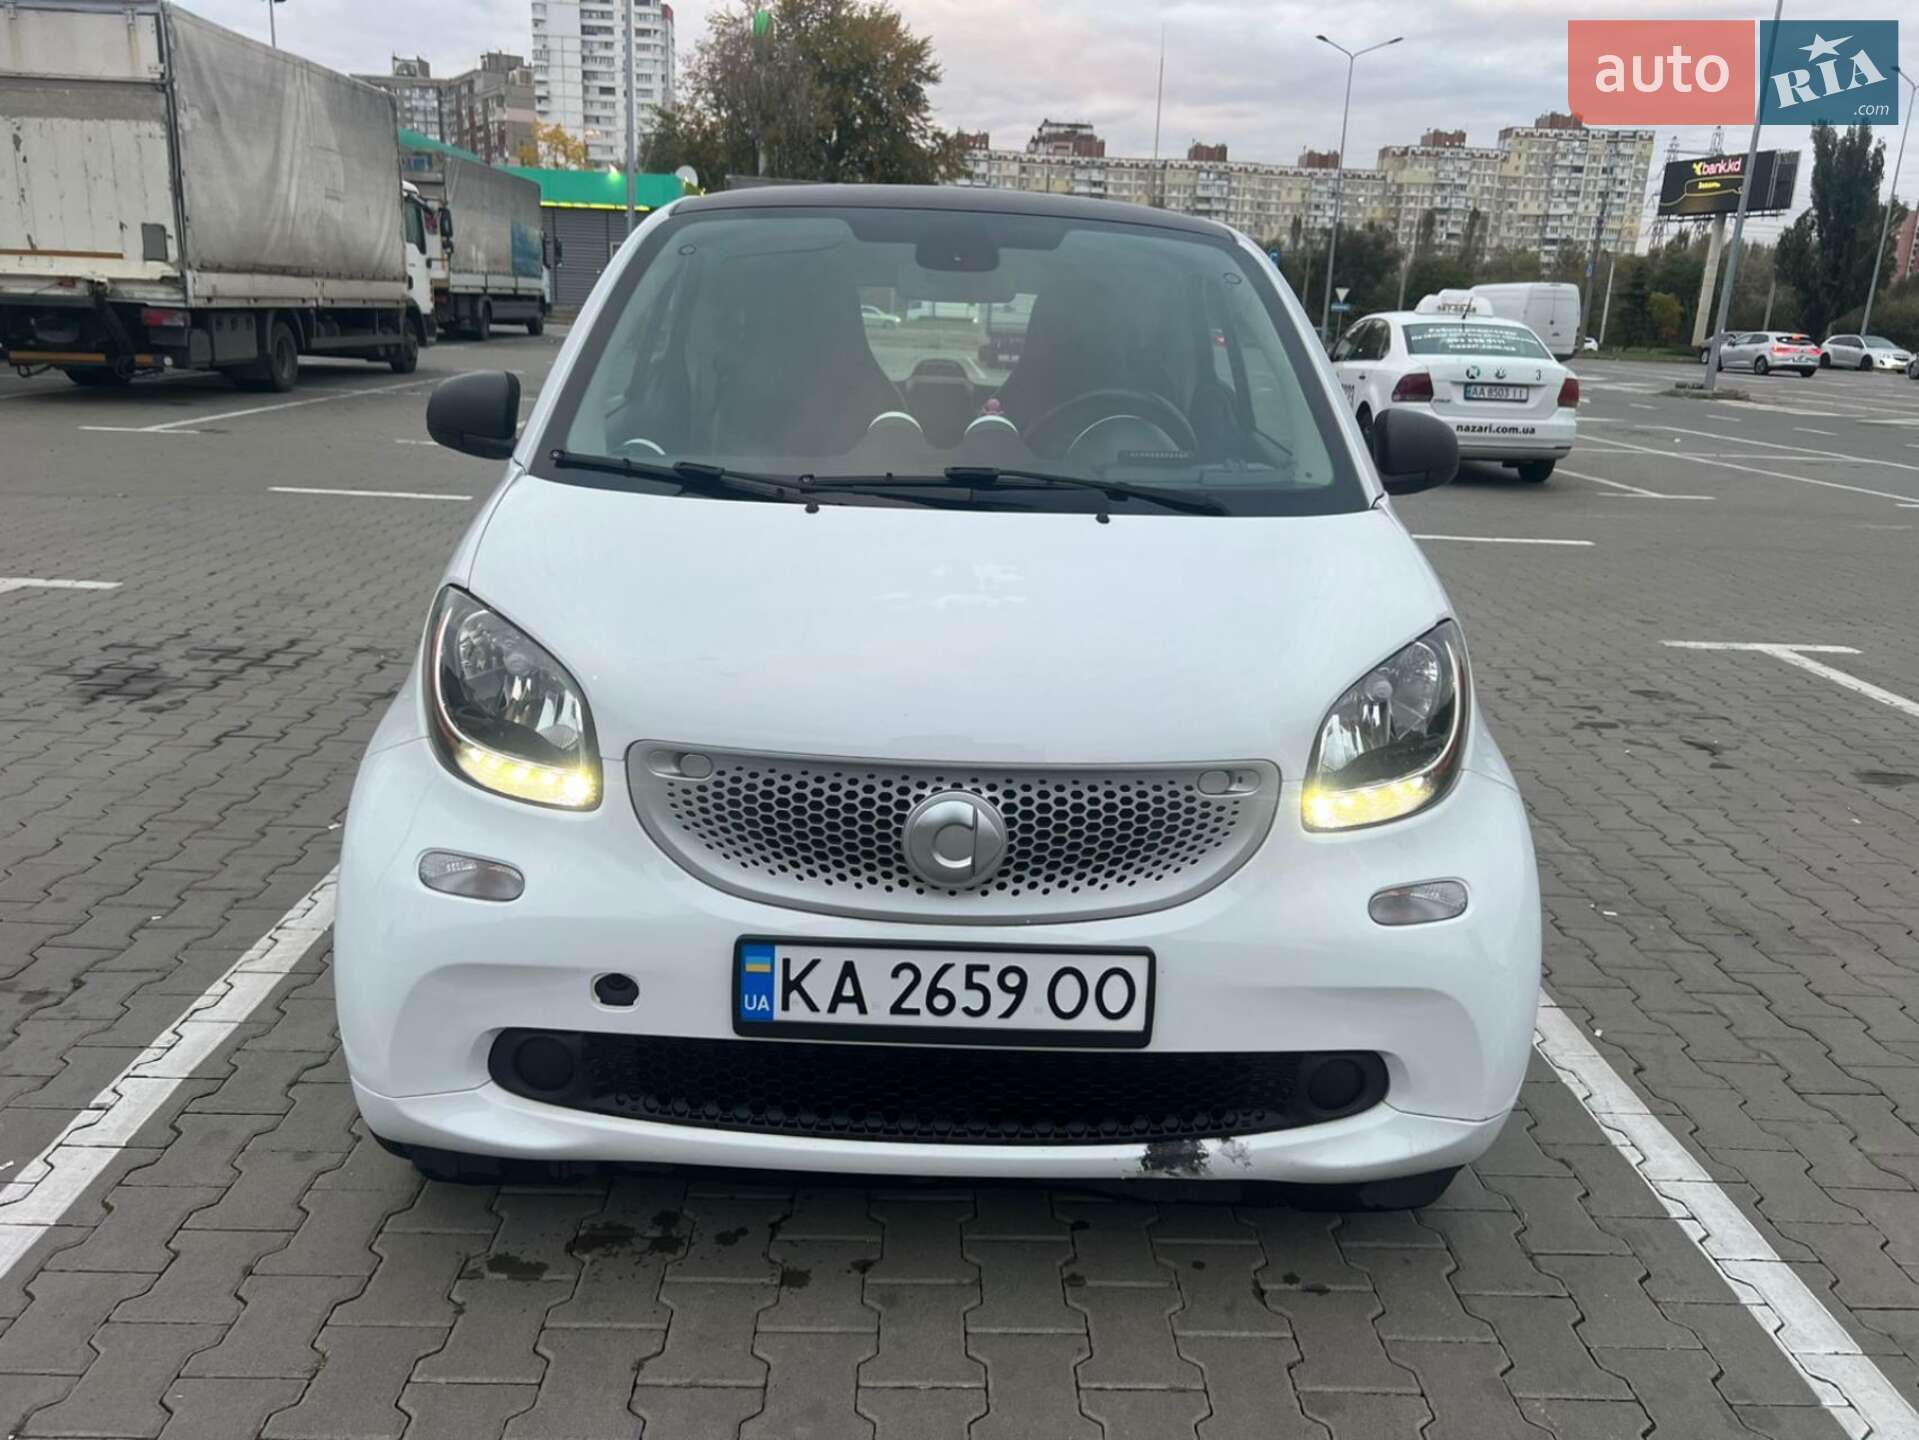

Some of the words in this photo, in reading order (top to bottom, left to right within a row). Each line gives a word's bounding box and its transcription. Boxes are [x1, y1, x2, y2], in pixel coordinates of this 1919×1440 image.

[1456, 423, 1536, 434] nazari.com.ua
[781, 957, 868, 1015] KA
[889, 961, 1028, 1019] 2659
[744, 994, 770, 1011] UA
